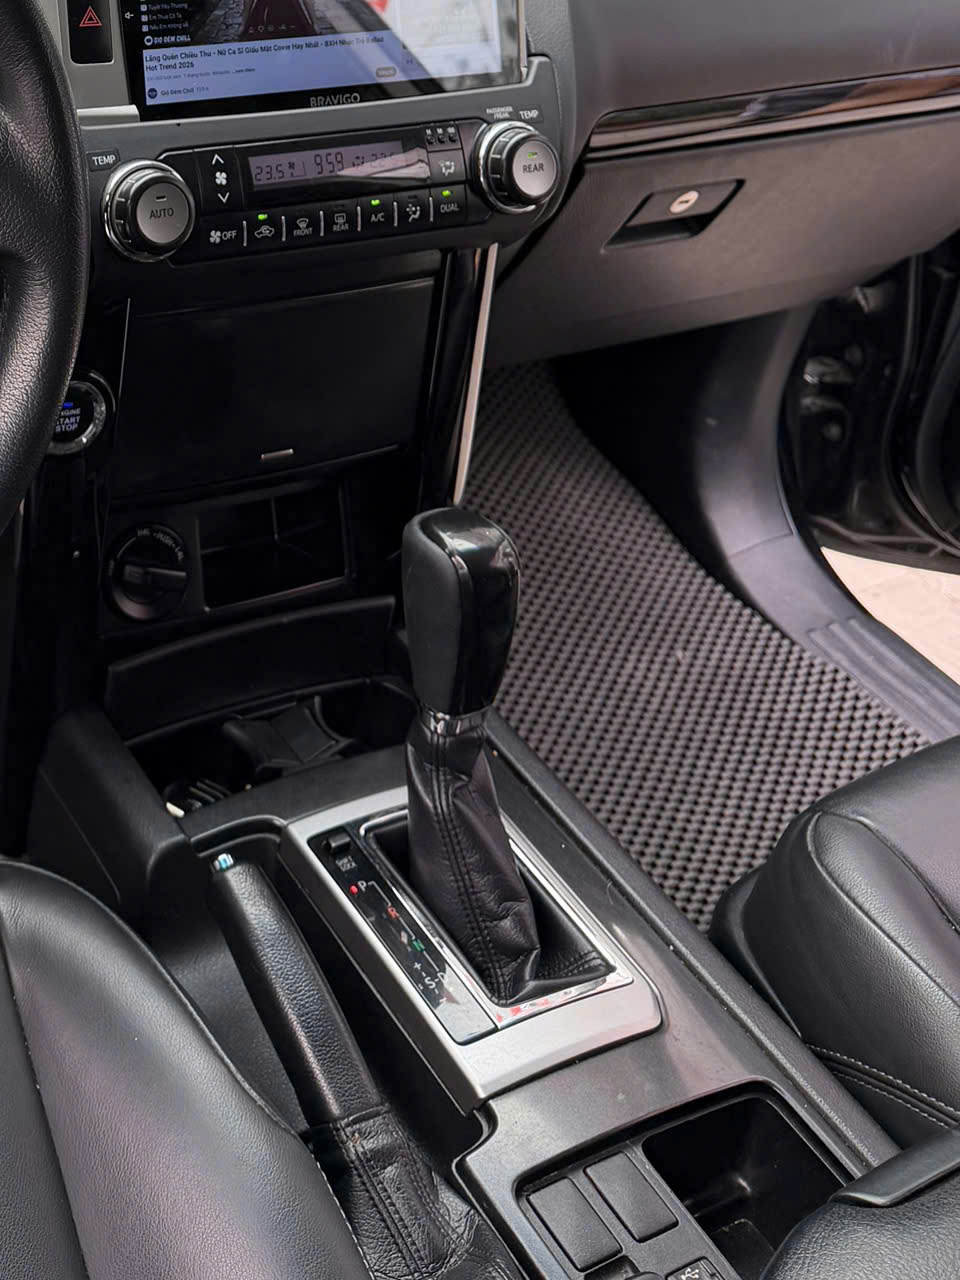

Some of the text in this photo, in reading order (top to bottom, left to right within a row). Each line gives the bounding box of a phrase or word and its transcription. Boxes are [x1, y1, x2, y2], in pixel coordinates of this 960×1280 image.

[199, 50, 211, 58] Thu
[146, 63, 157, 71] Hot
[160, 62, 177, 70] Trend
[310, 92, 360, 108] BRAVIGO
[520, 109, 539, 119] TEMP
[92, 154, 116, 166] TEMP
[254, 163, 285, 182] 23.5
[522, 162, 545, 174] REAR
[149, 207, 175, 219] AUTO
[440, 202, 460, 213] DUAL
[370, 212, 385, 223] A/C
[293, 226, 313, 237] FRONT
[332, 223, 349, 232] REAR
[221, 229, 237, 241] OFF
[358, 880, 367, 892] P
[387, 906, 398, 920] R
[425, 976, 436, 989] S
